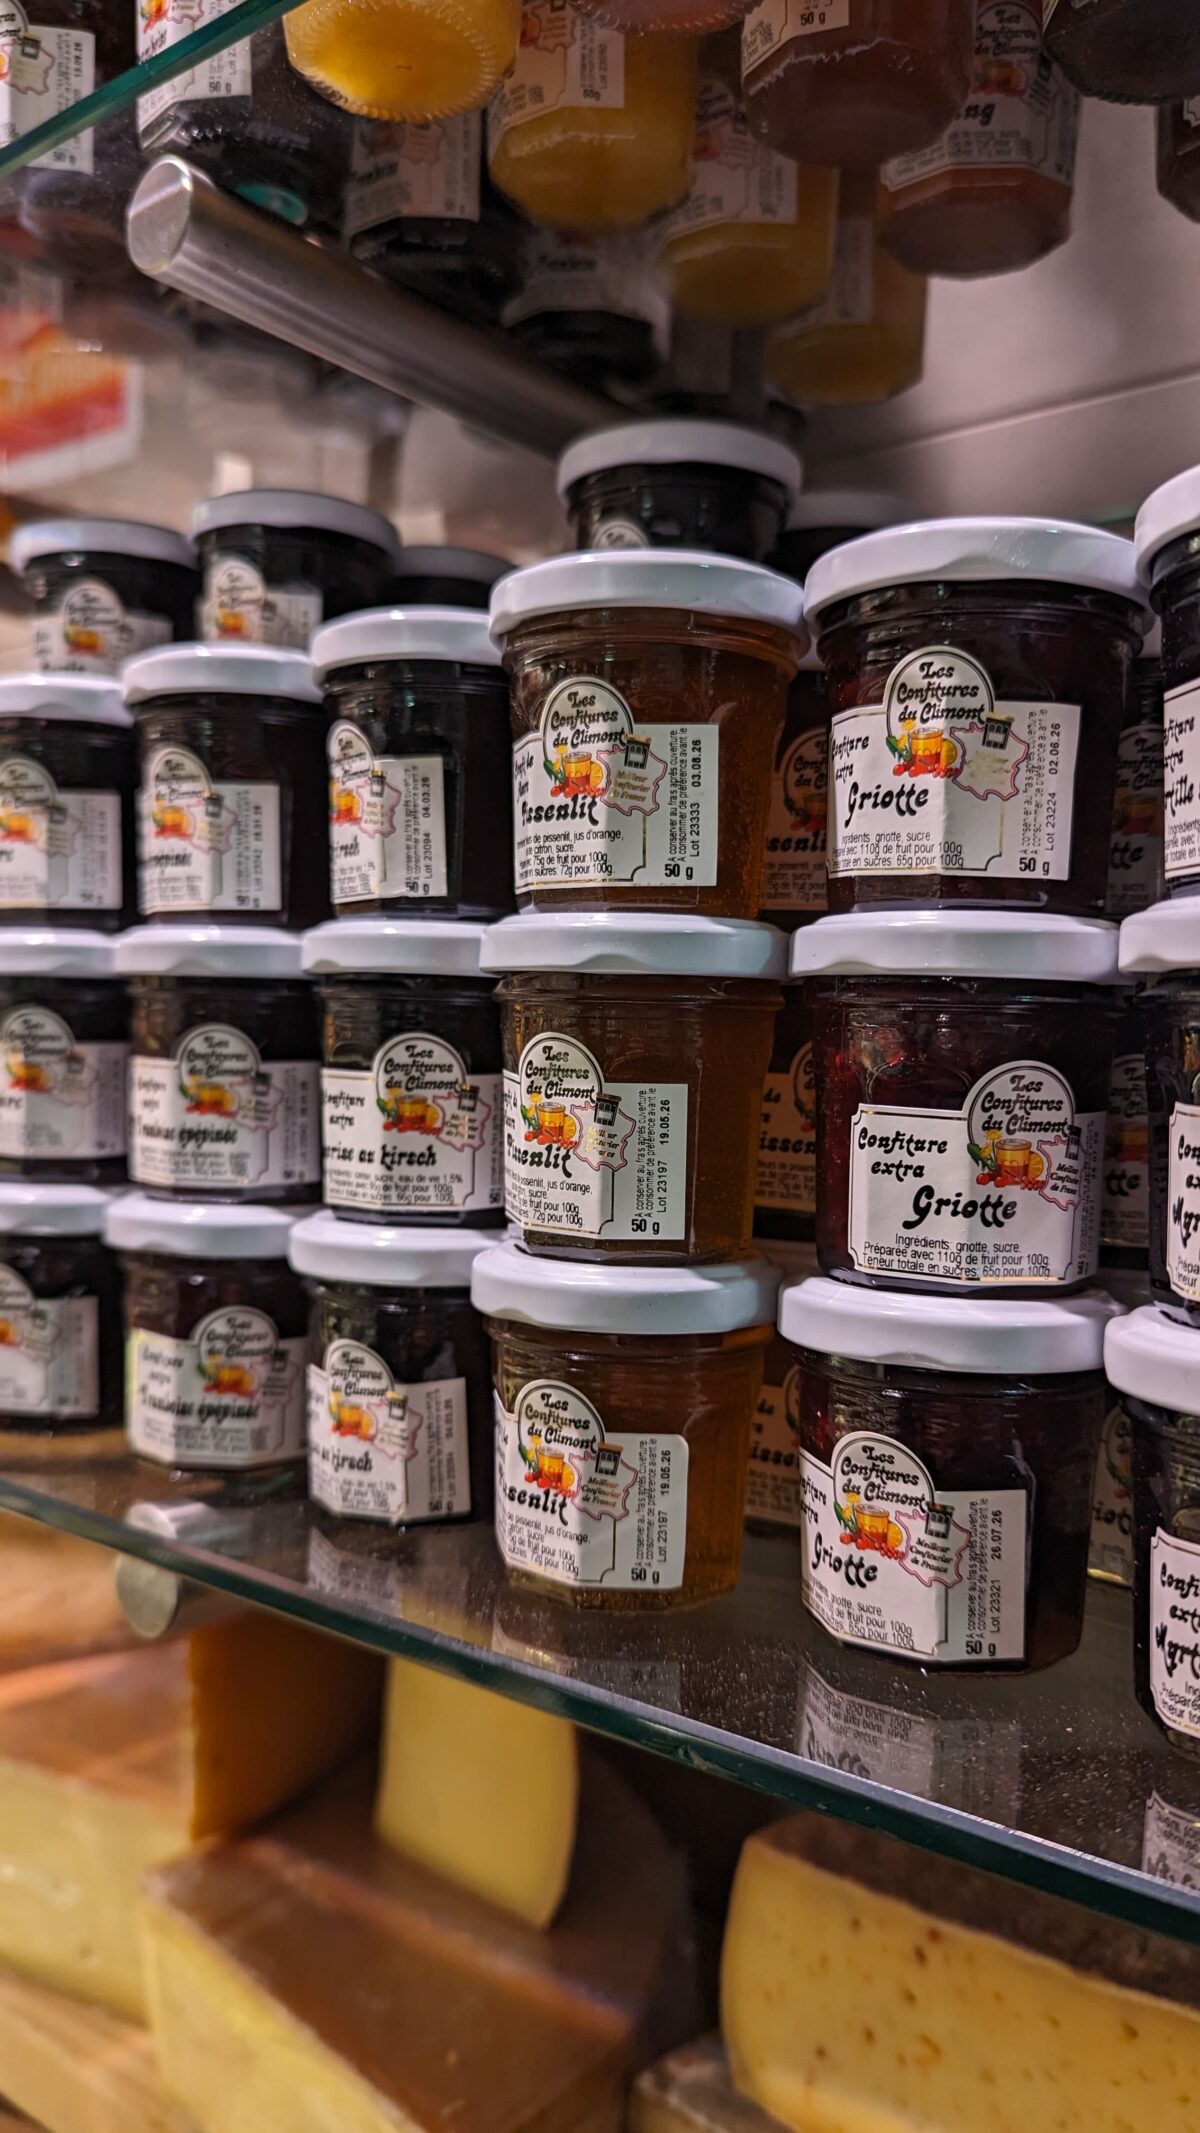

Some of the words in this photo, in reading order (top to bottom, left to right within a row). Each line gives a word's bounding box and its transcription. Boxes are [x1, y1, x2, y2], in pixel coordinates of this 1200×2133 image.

[801, 12, 814, 26] 50
[819, 13, 825, 24] g
[919, 661, 954, 679] Les
[568, 692, 596, 707] Les
[897, 681, 979, 705] Confitures
[551, 709, 619, 731] Confitures
[899, 706, 917, 722] du
[920, 703, 985, 724] Climont
[553, 732, 568, 748] du
[571, 728, 626, 749] Climont
[1049, 723, 1060, 775] 02.06.26
[691, 739, 701, 787] 03.08.26
[668, 767, 681, 788] après
[679, 759, 688, 798] préférence
[668, 790, 677, 805] frais
[679, 800, 687, 810] de
[844, 782, 929, 828] Griotte
[670, 808, 677, 816] au
[690, 802, 700, 836] 23333
[1046, 792, 1056, 828] 23224
[533, 834, 541, 843] de
[543, 831, 571, 845] pissenlit,
[574, 831, 584, 843] jus
[586, 830, 624, 841] d'orange,
[669, 819, 677, 854] conserver
[679, 812, 687, 854] consommer
[875, 832, 904, 845] griotte,
[906, 831, 933, 842] sucre.
[1045, 833, 1055, 851] Lot
[690, 840, 699, 857] Lot
[860, 844, 879, 856] 110g
[883, 845, 892, 854] de
[896, 843, 911, 853] fruit
[914, 844, 934, 855] pour
[533, 855, 545, 868] 75g
[546, 855, 555, 864] de
[557, 854, 569, 865] fruit
[571, 854, 587, 866] pour
[561, 864, 573, 877] 72g
[575, 865, 590, 876] pour
[897, 855, 913, 868] 65g
[916, 856, 936, 868] pour
[941, 854, 963, 868] 100g
[1019, 857, 1036, 873] 50
[1042, 861, 1050, 876] g
[424, 865, 432, 879] Lot
[665, 864, 680, 878] 50
[686, 866, 693, 880] g
[405, 1045, 434, 1059] Les
[543, 1046, 569, 1062] Les
[384, 1058, 454, 1081] Confitures
[525, 1060, 590, 1082] Confitures
[405, 1076, 460, 1092] Climont
[526, 1080, 543, 1095] du
[544, 1083, 595, 1104] Climont
[1009, 1074, 1044, 1093] Les
[980, 1091, 1064, 1119] Confitures
[660, 1099, 670, 1145] 19.05.26
[981, 1115, 1003, 1132] du
[1006, 1116, 1069, 1138] Climont
[646, 1119, 656, 1156] préférence
[858, 1127, 948, 1157] Confiture
[658, 1160, 667, 1193] 23197
[871, 1159, 925, 1182] extra
[547, 1181, 557, 1191] jus
[560, 1181, 593, 1195] d'orange,
[636, 1176, 645, 1210] conserver
[529, 1198, 541, 1210] fruit
[544, 1202, 559, 1214] pour
[657, 1196, 666, 1213] Lot
[901, 1184, 1017, 1230] Griotte
[533, 1209, 545, 1223] 72g
[547, 1214, 564, 1224] pour
[631, 1219, 647, 1232] 50
[652, 1221, 660, 1235] g
[864, 1241, 907, 1257] Préparée
[911, 1249, 934, 1261] avec
[937, 1252, 962, 1267] 110g
[966, 1253, 978, 1265] de
[981, 1253, 999, 1266] fruit
[1002, 1255, 1023, 1268] pour
[895, 1233, 952, 1250] Ingrédients:
[956, 1241, 990, 1255] griotte,
[863, 1252, 893, 1268] Teneur
[897, 1258, 924, 1272] totale
[928, 1263, 940, 1273] en
[982, 1266, 1000, 1278] 65g
[1002, 1266, 1023, 1278] pour
[540, 1392, 569, 1411] Les
[525, 1403, 590, 1430] Confitures
[527, 1424, 542, 1437] du
[544, 1429, 597, 1454] Climont
[861, 1445, 895, 1464] Les
[660, 1450, 671, 1495] 19.05.26
[840, 1456, 919, 1486] Confitures
[842, 1478, 861, 1494] du
[863, 1481, 929, 1513] Climont
[544, 1524, 555, 1535] jus
[556, 1528, 591, 1545] d'orange,
[658, 1510, 668, 1543] 23197
[541, 1544, 556, 1556] pour
[657, 1546, 667, 1562] Lot
[811, 1531, 879, 1588] Griotte
[545, 1556, 559, 1568] pour
[631, 1568, 646, 1582] 50
[652, 1571, 660, 1584] g
[990, 1579, 1000, 1613] 23321
[847, 1610, 863, 1624] fruit
[866, 1616, 886, 1629] pour
[990, 1616, 1000, 1633] Lot
[868, 1628, 888, 1641] pour
[966, 1640, 982, 1655] 50
[989, 1643, 996, 1657] g
